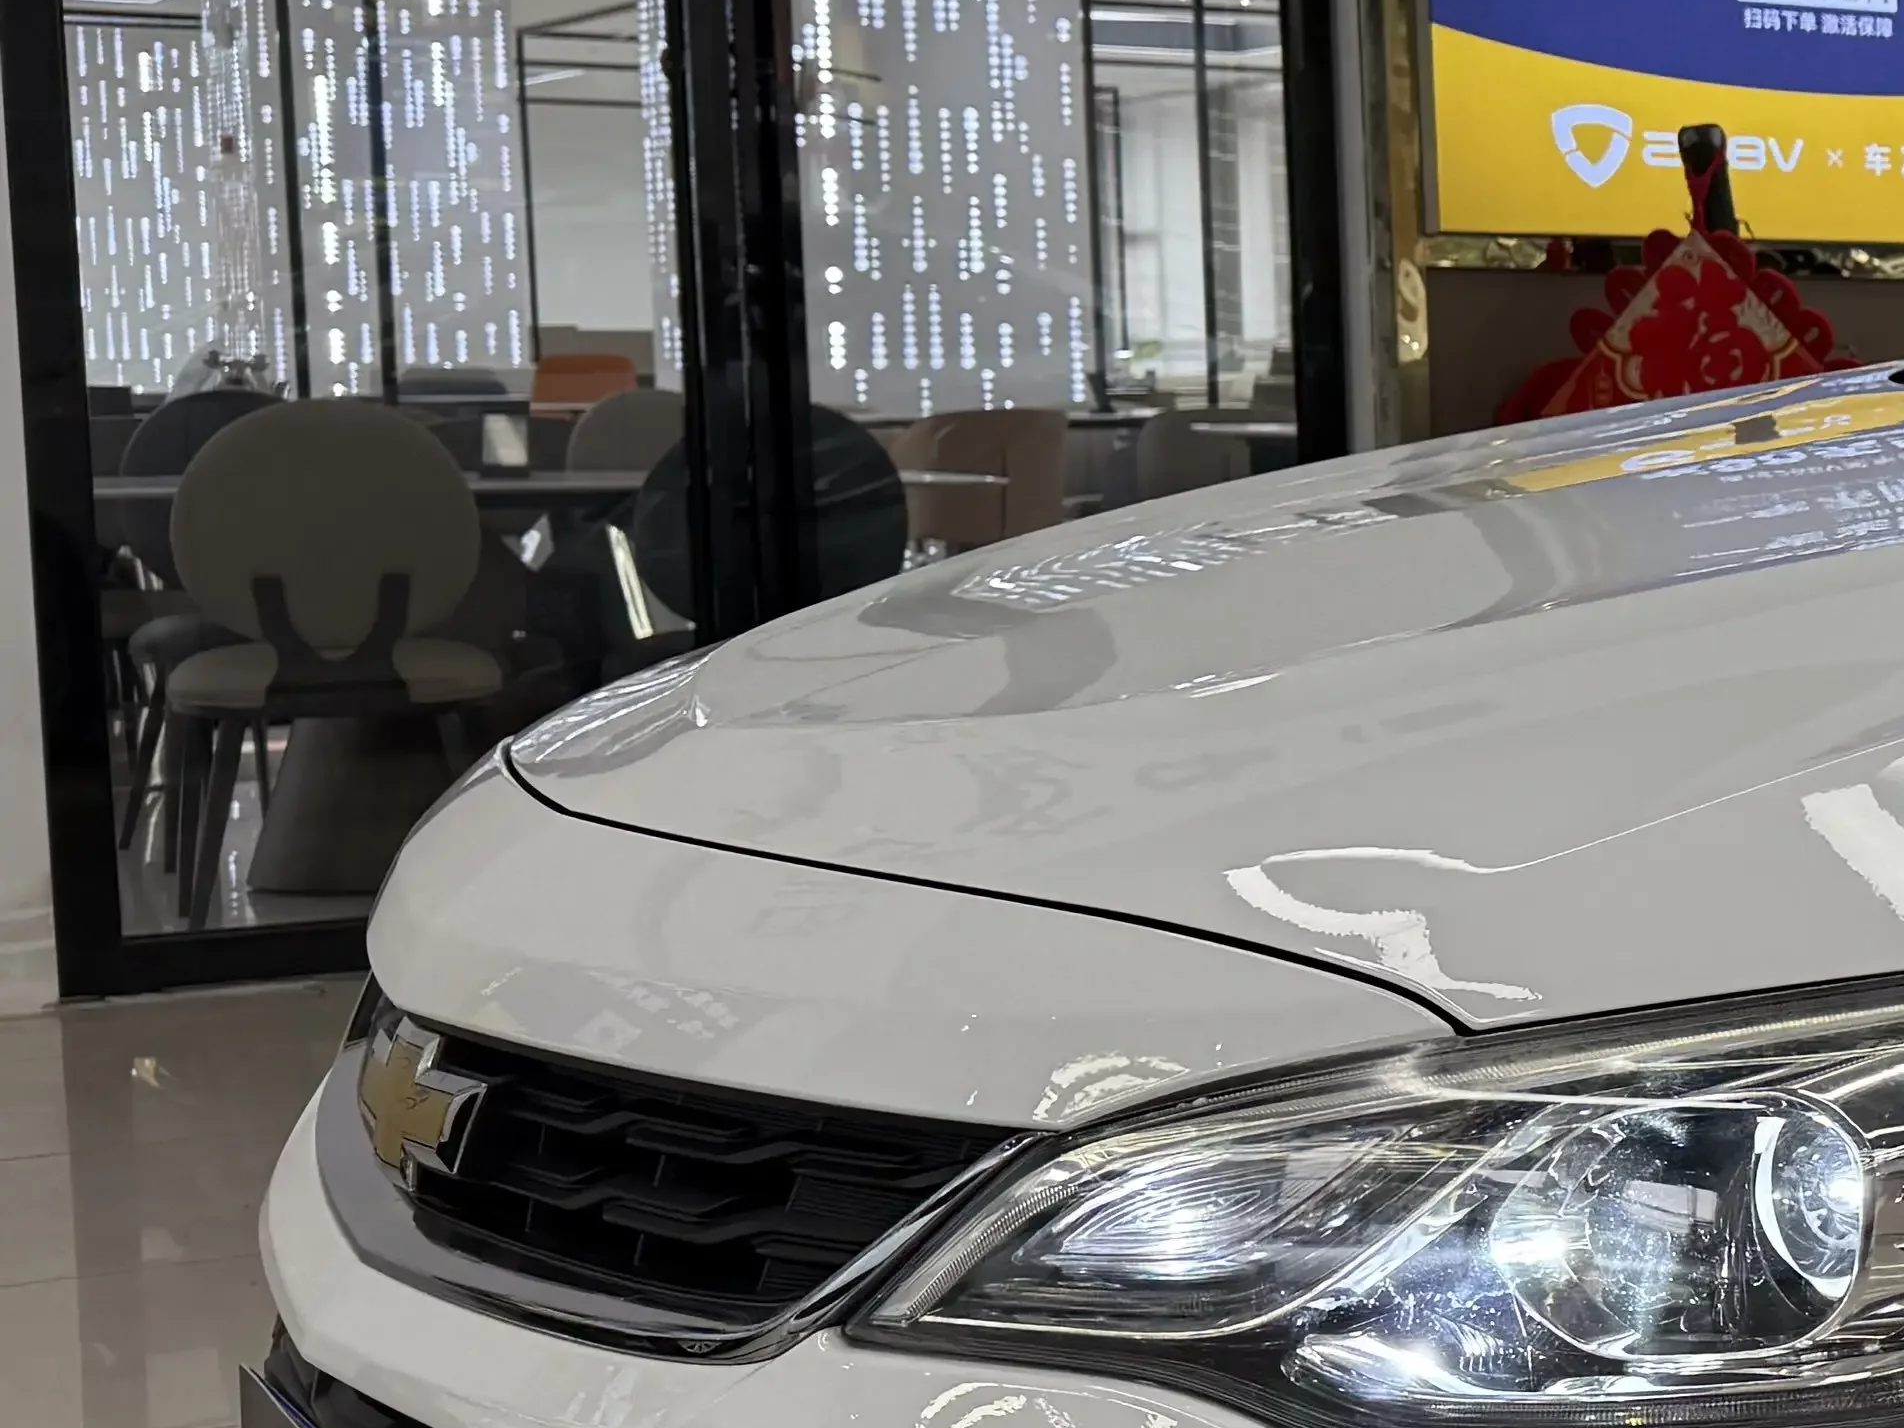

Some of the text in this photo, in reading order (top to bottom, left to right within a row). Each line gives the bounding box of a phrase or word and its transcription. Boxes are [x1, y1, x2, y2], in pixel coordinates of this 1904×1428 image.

[1744, 7, 1818, 33] 扫码下单
[1642, 131, 1804, 173] 28V
